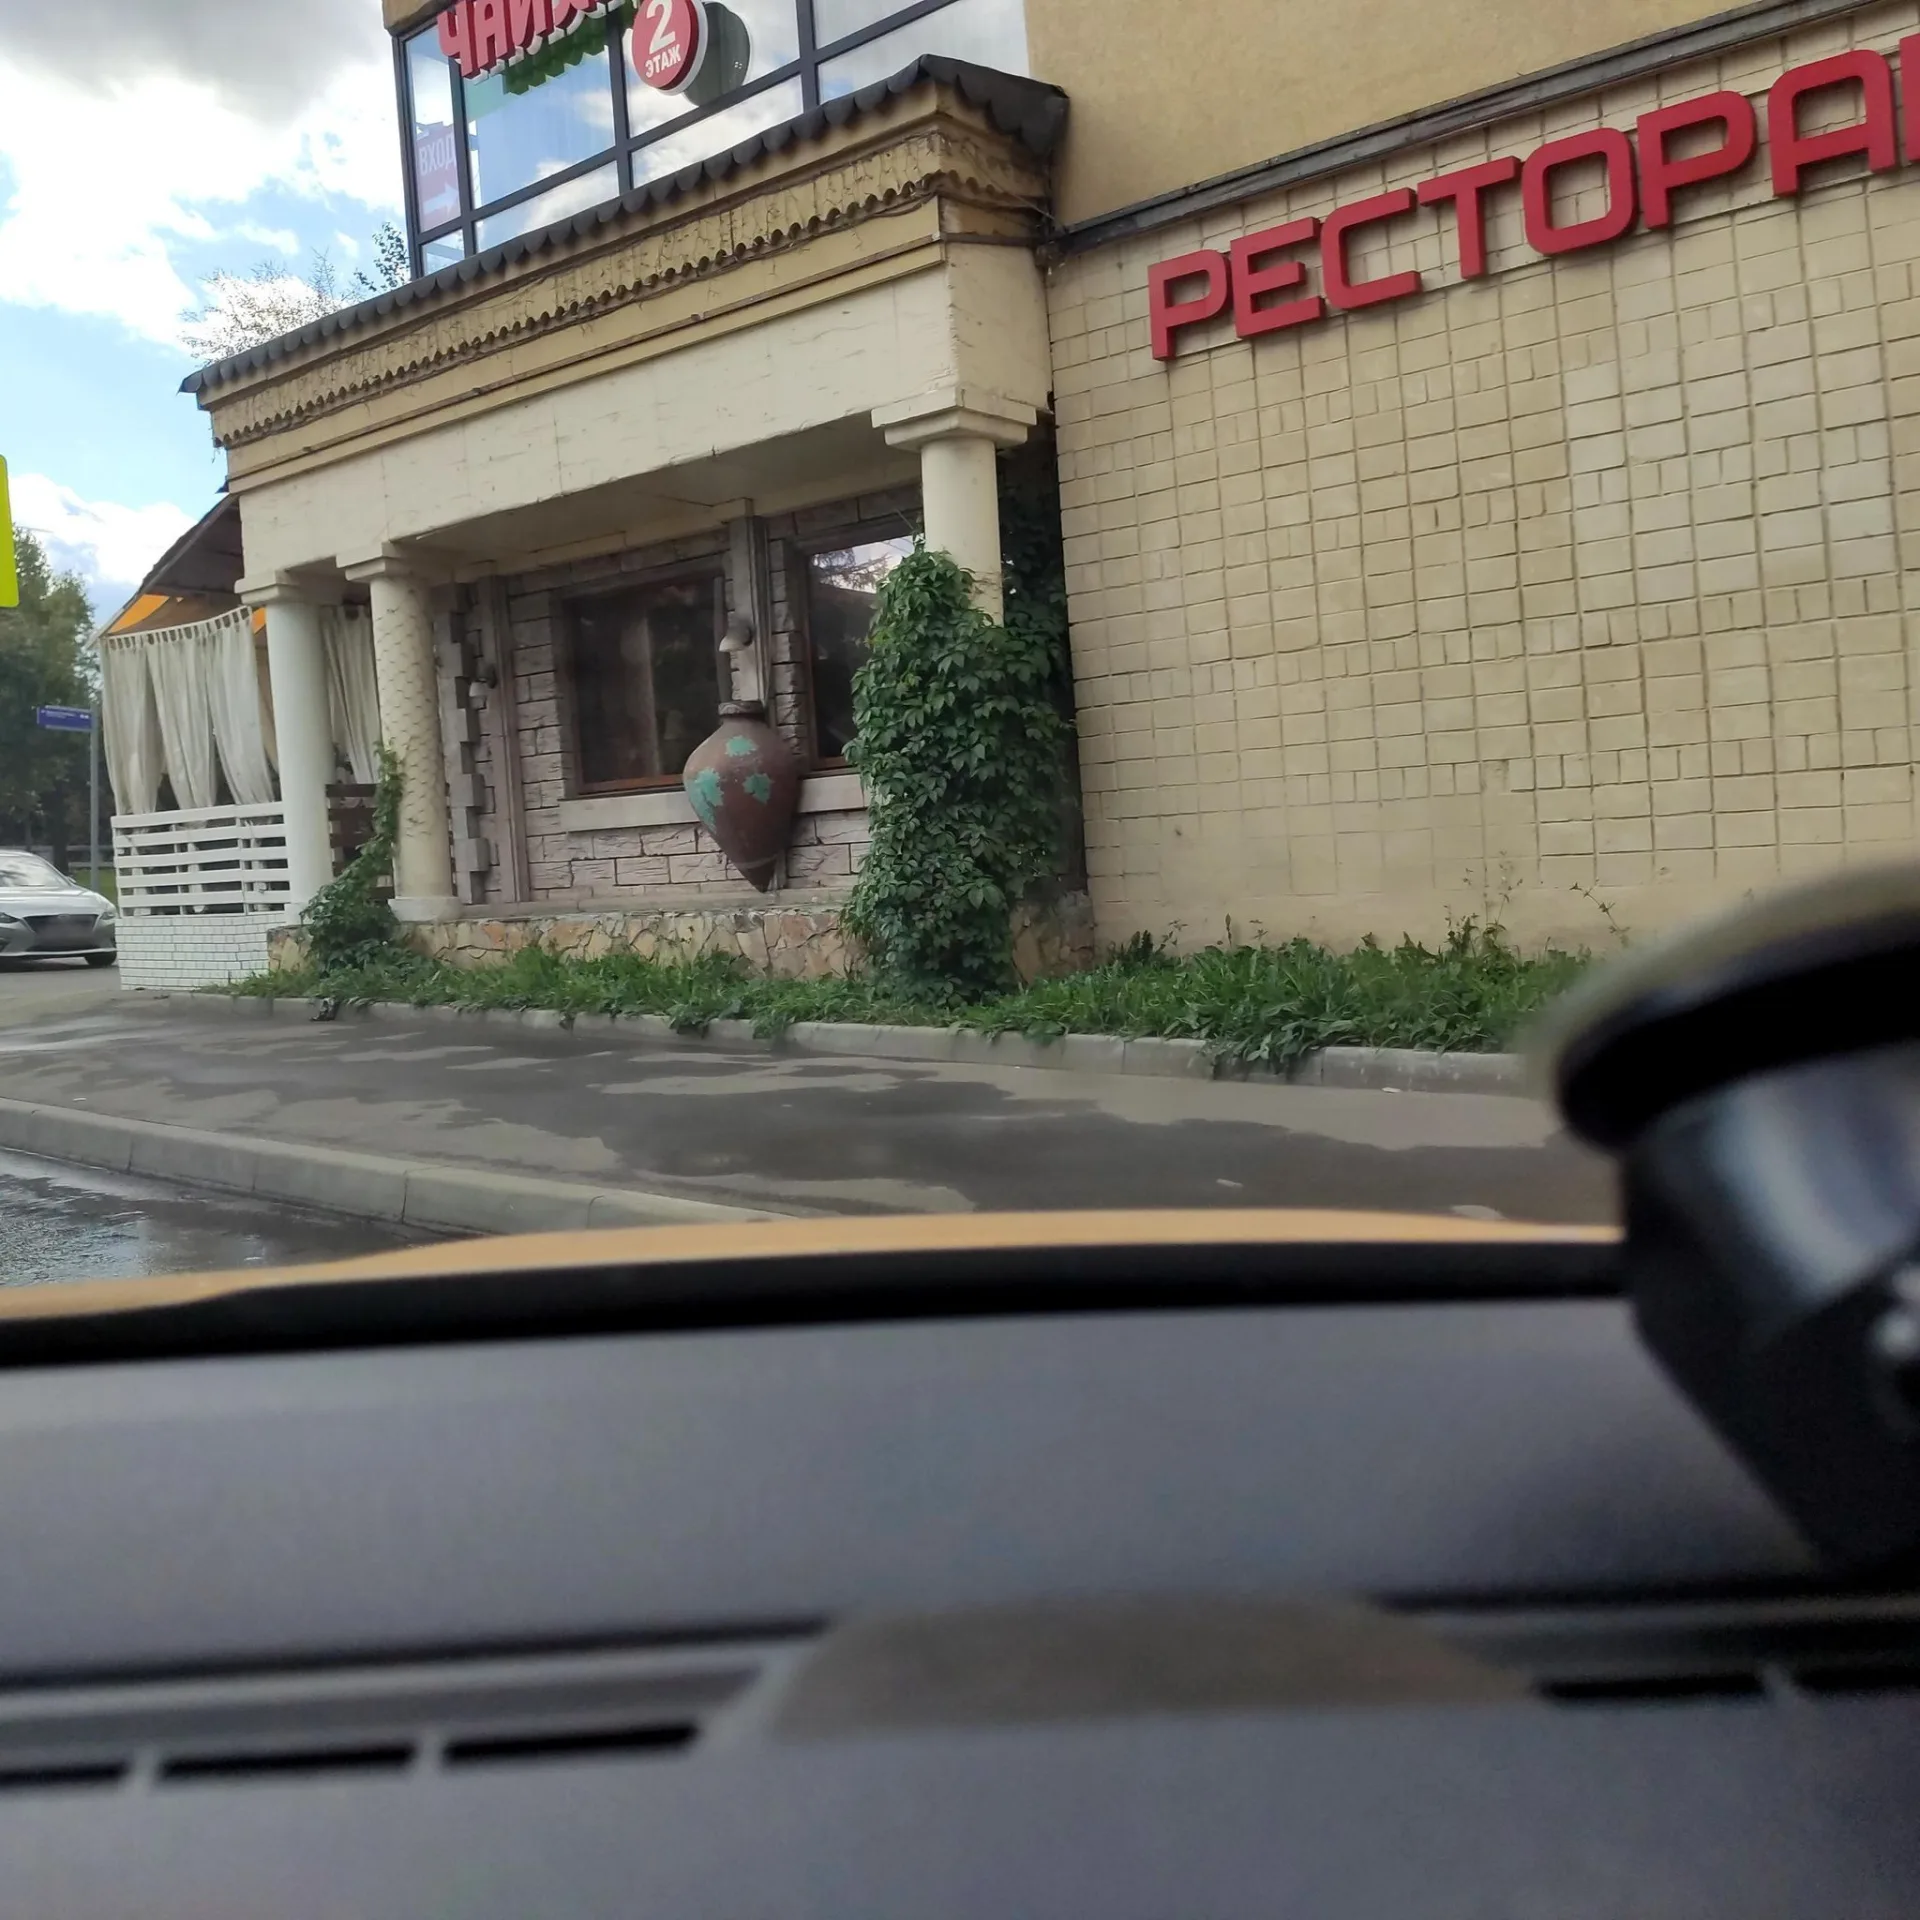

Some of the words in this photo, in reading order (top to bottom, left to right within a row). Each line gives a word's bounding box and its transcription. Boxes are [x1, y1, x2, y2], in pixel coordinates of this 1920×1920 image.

[646, 0, 676, 54] 2
[645, 44, 681, 78] ЭТАЖ
[419, 132, 457, 176] ВХОД
[1147, 33, 1920, 361] РЕСТОРА
